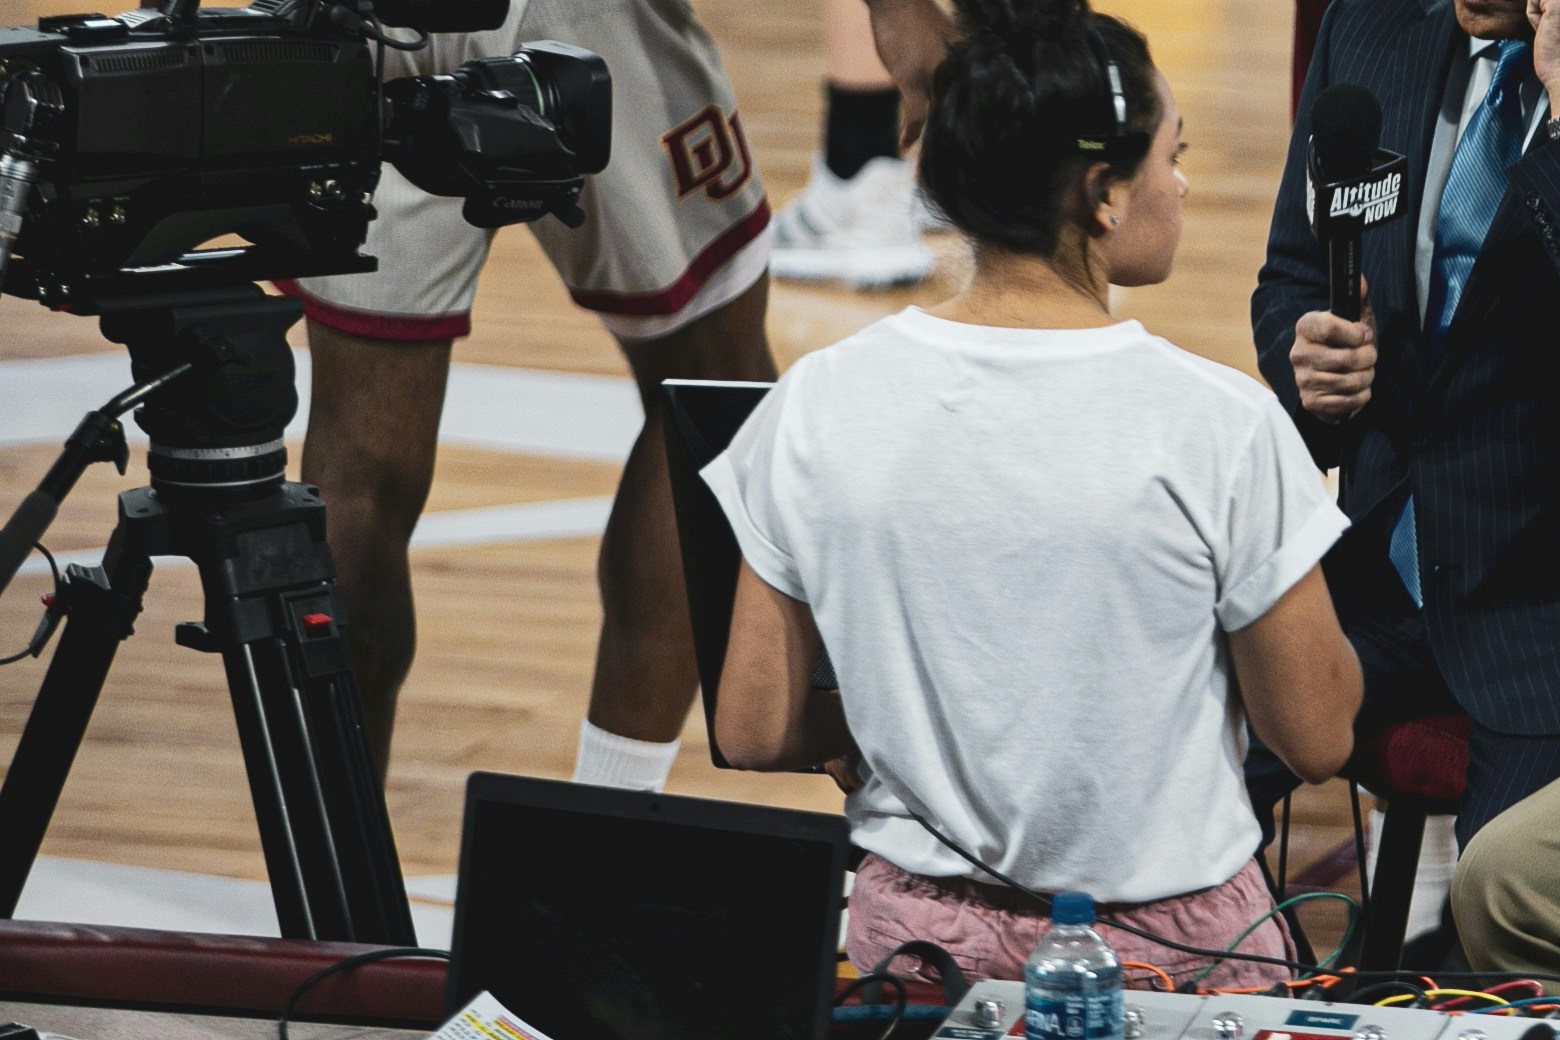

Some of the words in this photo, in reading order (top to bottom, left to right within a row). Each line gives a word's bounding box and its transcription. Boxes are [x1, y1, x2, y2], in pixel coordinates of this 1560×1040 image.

[658, 103, 752, 202] DU
[492, 196, 543, 209] Canon
[1329, 172, 1401, 213] Altitude
[1364, 195, 1398, 226] NOW
